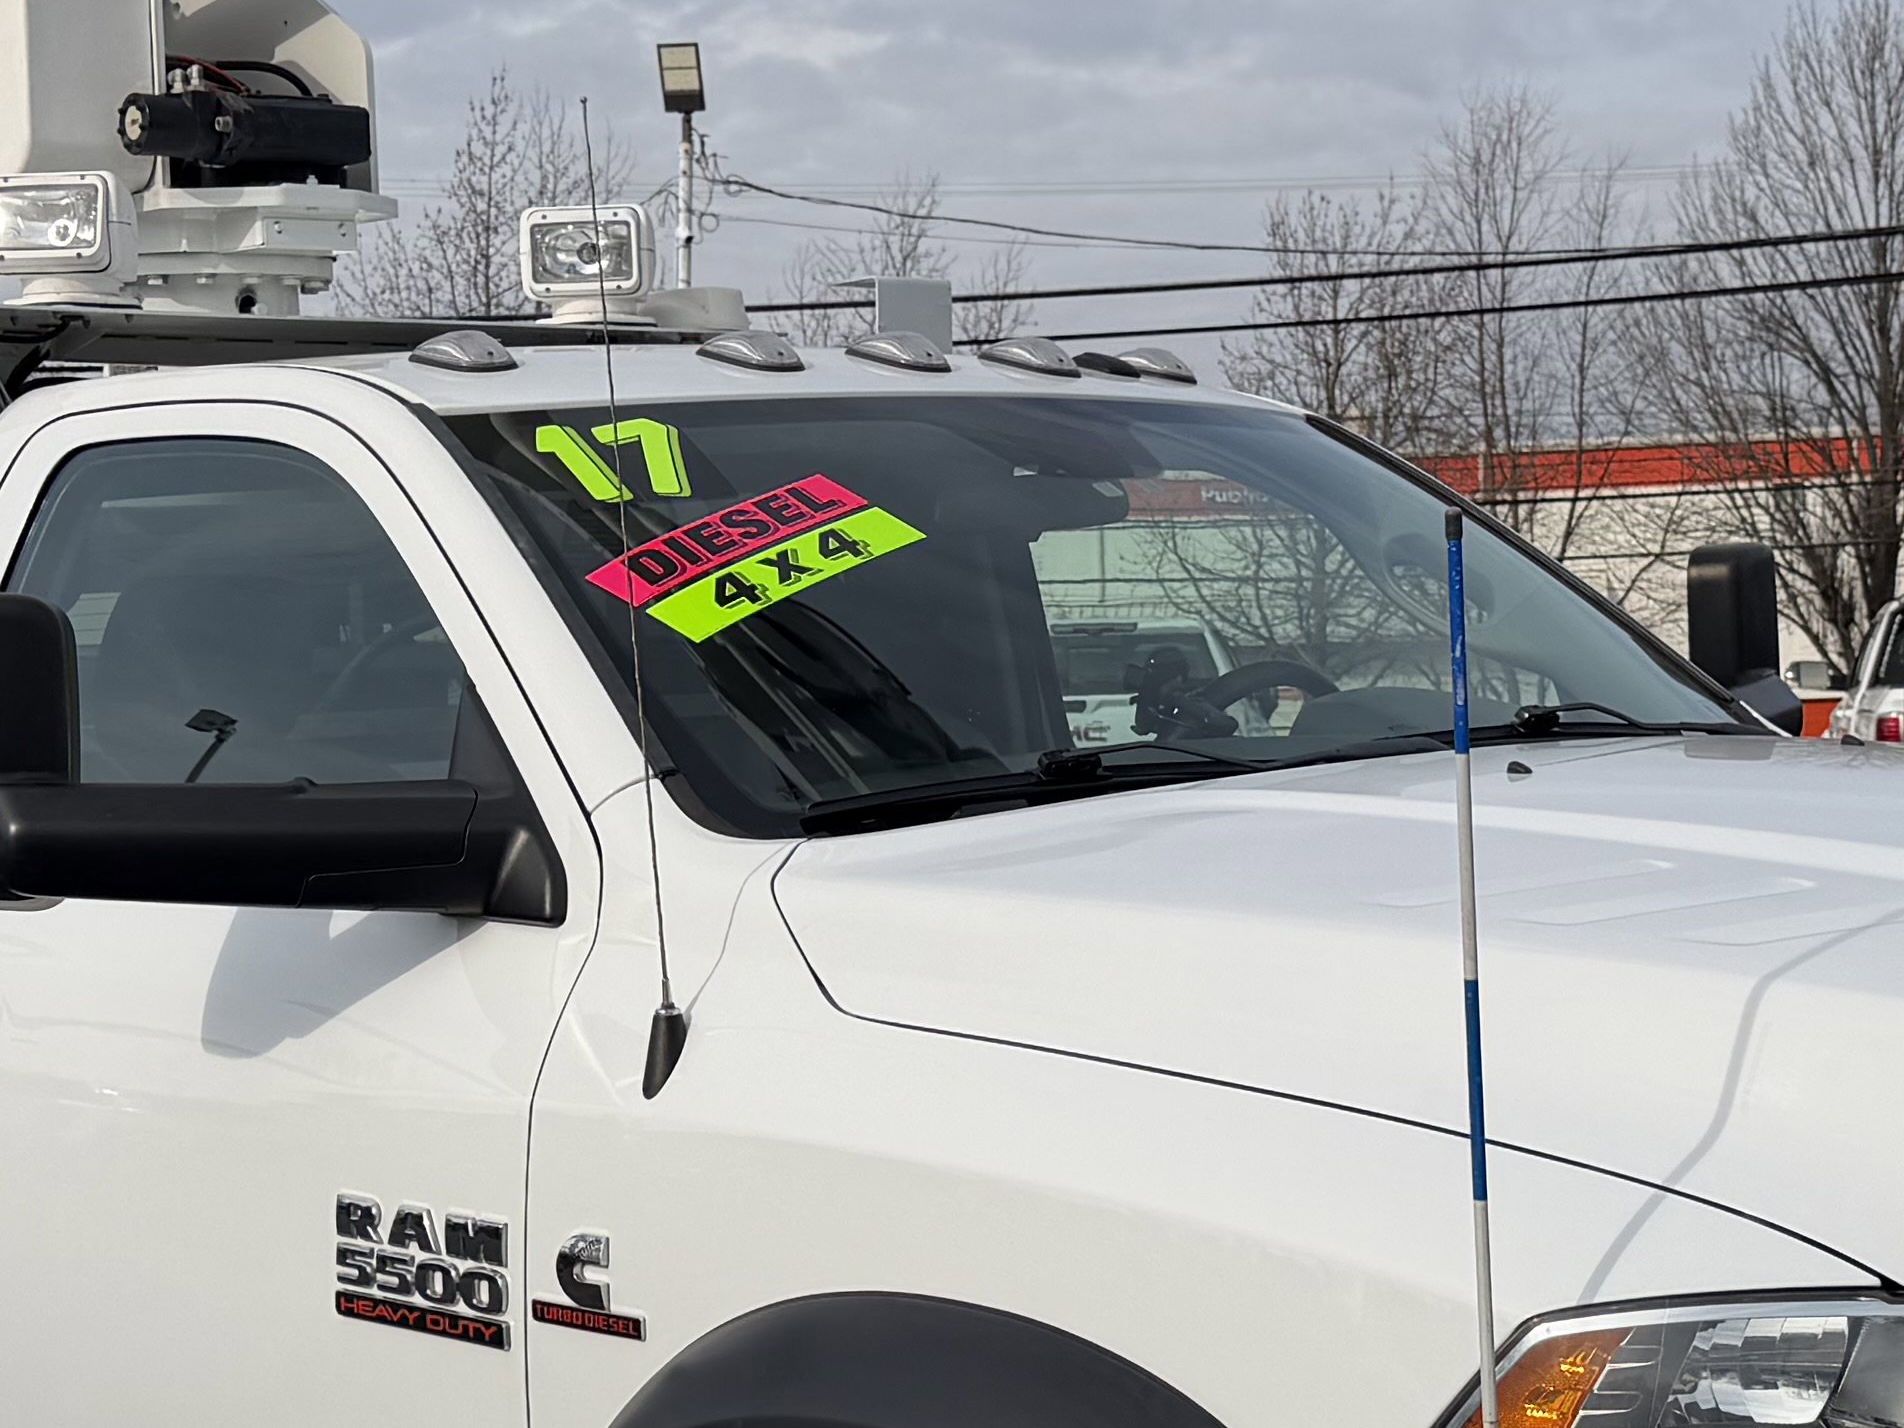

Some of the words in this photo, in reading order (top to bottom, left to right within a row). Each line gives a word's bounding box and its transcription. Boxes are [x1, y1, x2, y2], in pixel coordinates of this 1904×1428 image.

[535, 417, 692, 503] 17
[626, 487, 846, 589] DIESEL
[336, 1190, 510, 1268] RAM
[336, 1241, 511, 1317] 5500
[339, 1296, 422, 1326] HEAVY
[425, 1312, 499, 1343] DUTY
